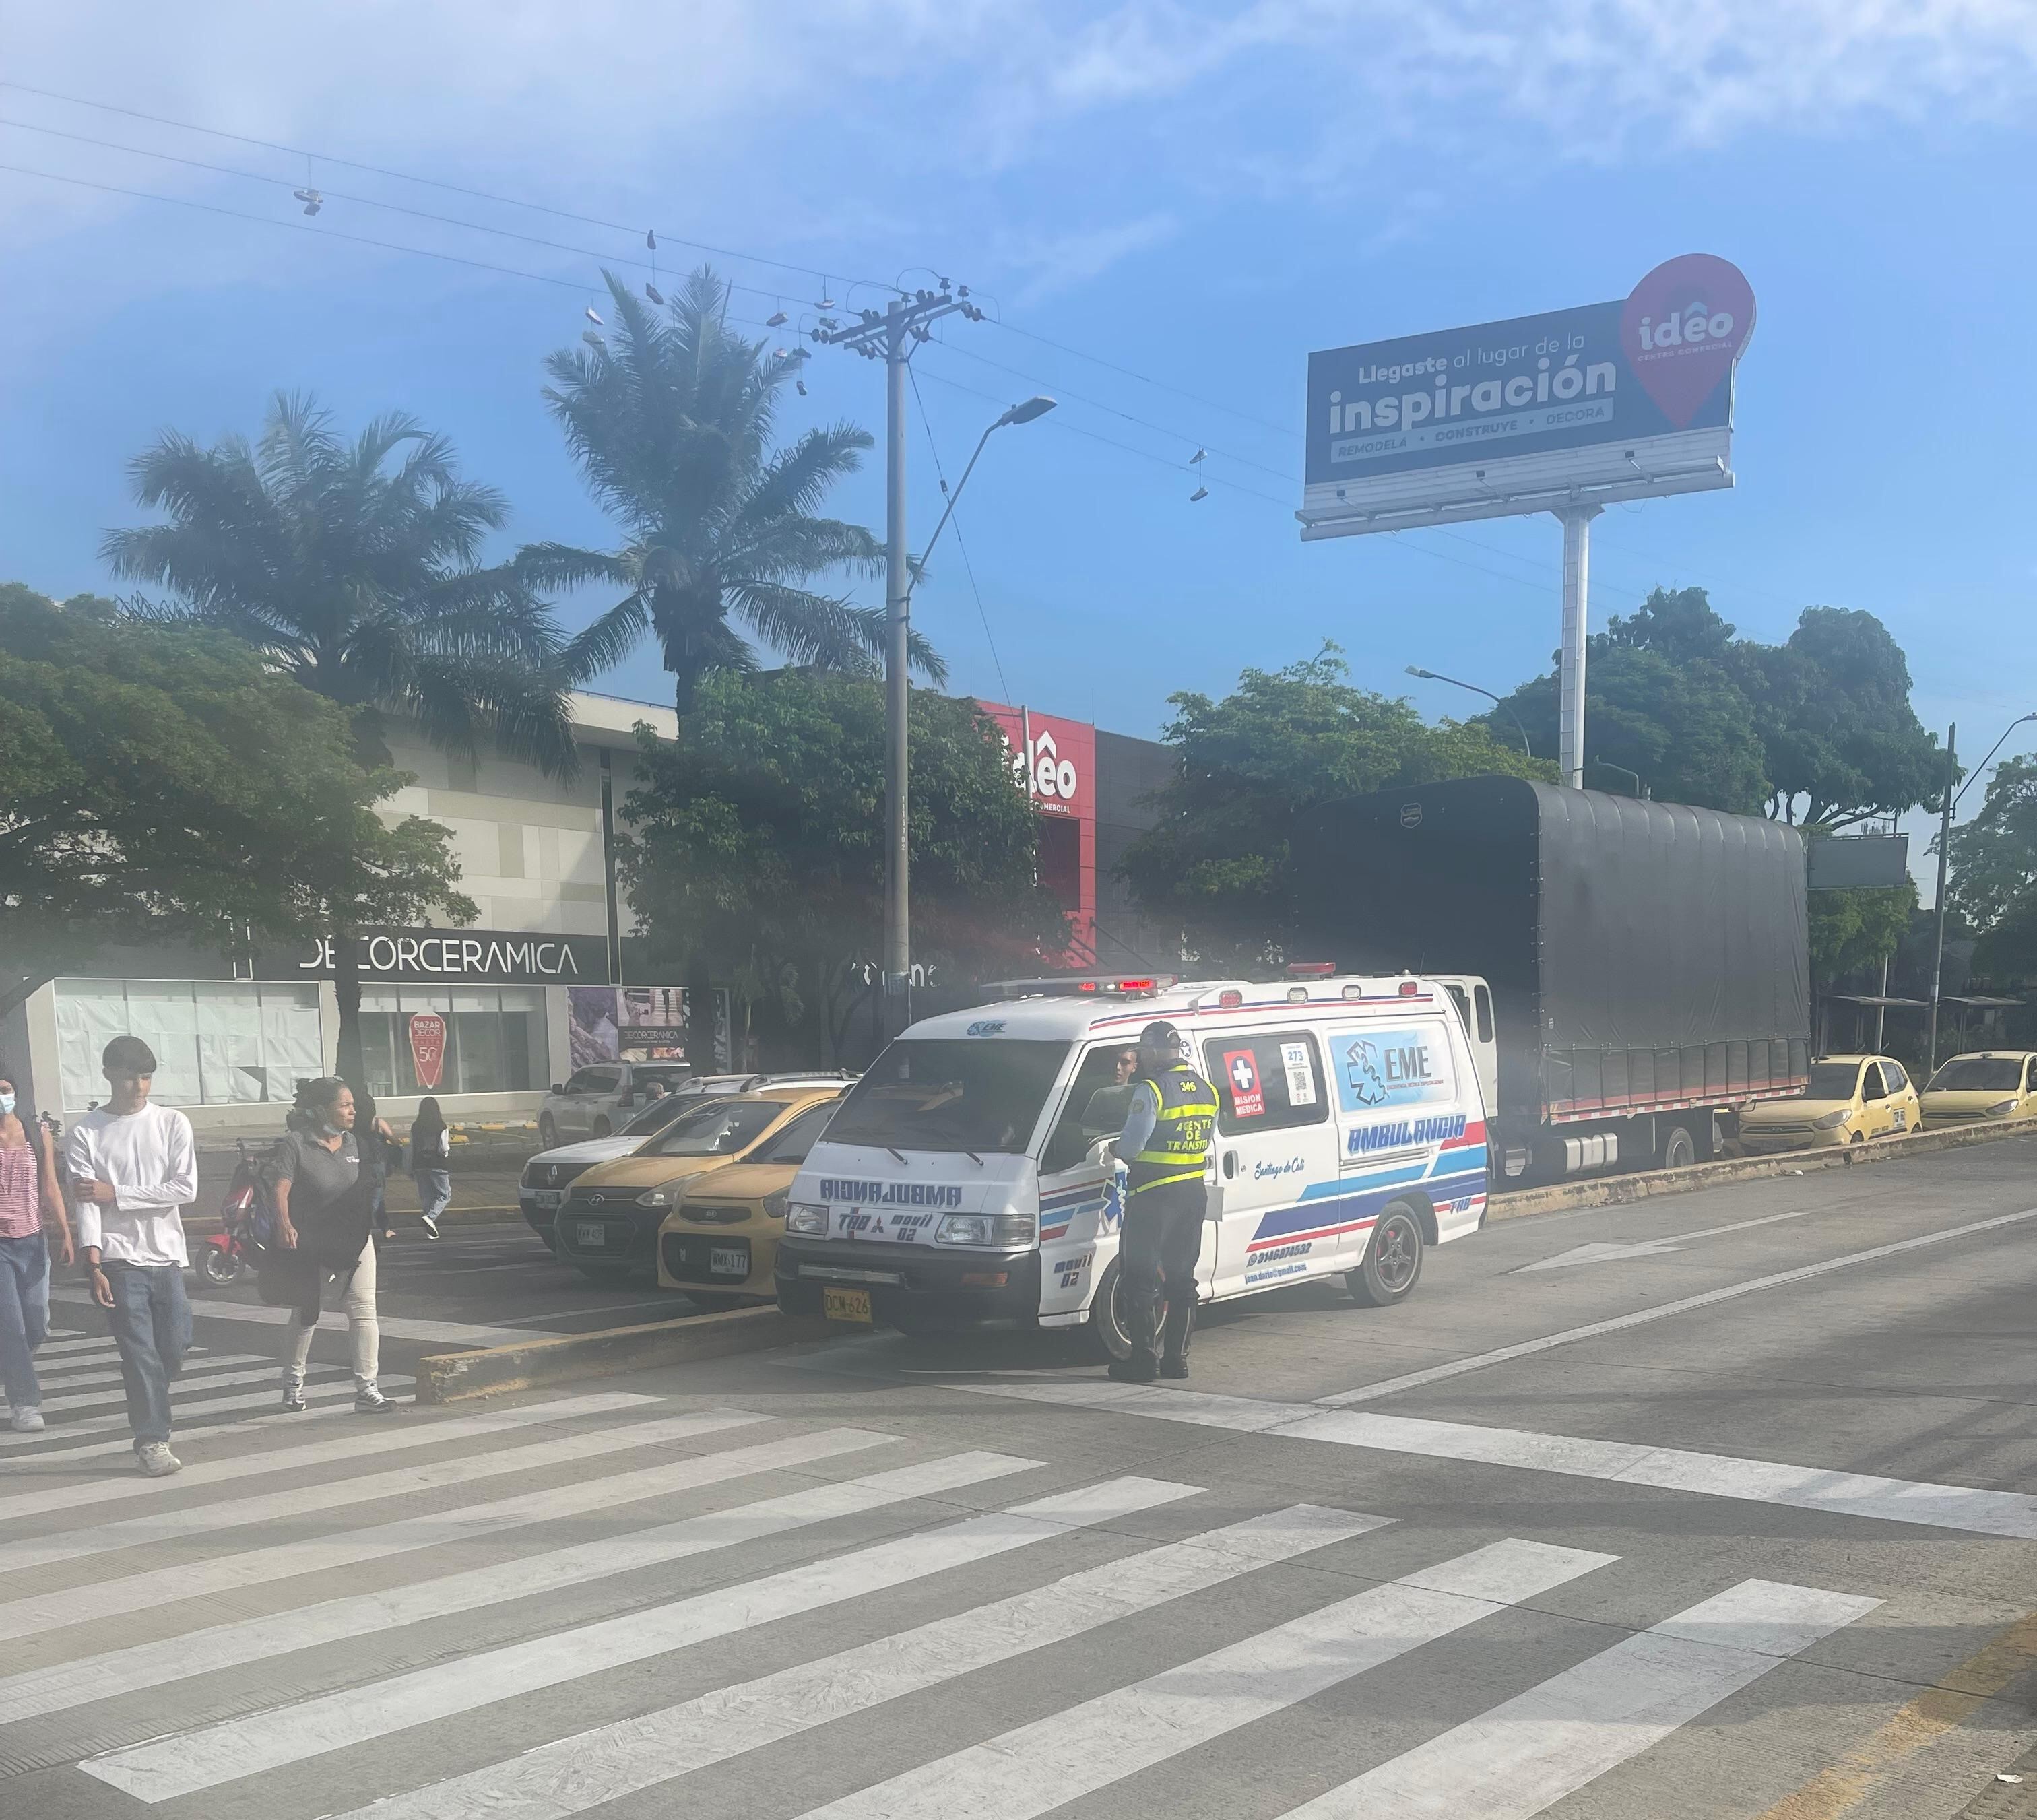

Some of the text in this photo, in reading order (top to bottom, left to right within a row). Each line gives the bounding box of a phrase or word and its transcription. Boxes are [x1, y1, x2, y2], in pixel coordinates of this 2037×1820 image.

[1678, 341, 1733, 355] COMERCIAL
[1359, 332, 1584, 384] Llegaste al lugar de la
[1330, 354, 1617, 434] inspiración
[1435, 420, 1518, 442] CONSTRUYE
[1546, 406, 1605, 425] DECORA
[982, 1021, 1007, 1031] EME
[624, 1031, 678, 1039] DECORCERAMICA
[1287, 1051, 1303, 1062] 273
[1384, 1045, 1432, 1082] EME
[1234, 1094, 1262, 1105] MISION
[1235, 1103, 1263, 1115] MEDICA
[1175, 1119, 1212, 1132] AGENTE
[1186, 1131, 1201, 1140] DE
[1347, 1114, 1467, 1154] AMBULANCIA
[1254, 1156, 1305, 1180] Santiago de Cali
[1450, 1197, 1473, 1214] TAB
[839, 1214, 872, 1231] TAB
[897, 1227, 917, 1241] 02
[1060, 1272, 1080, 1289] 02
